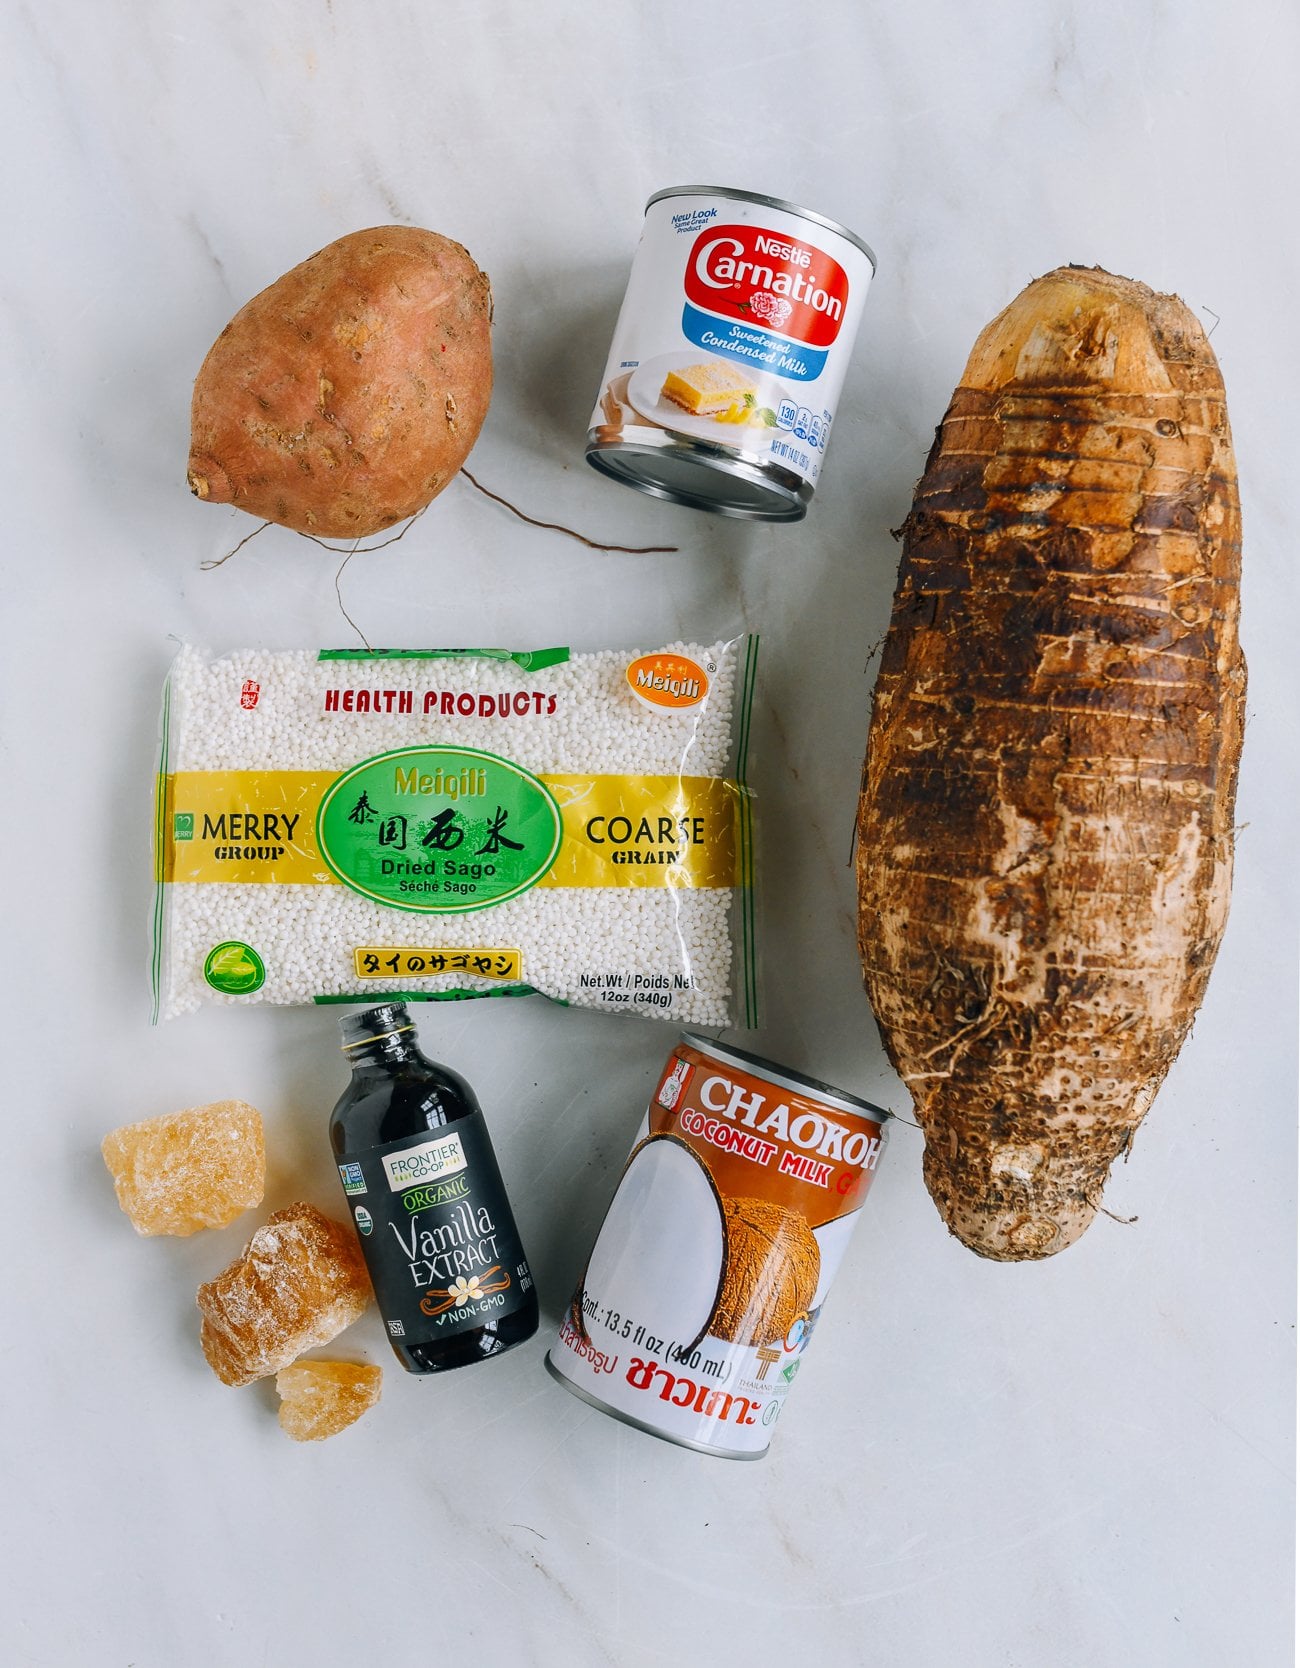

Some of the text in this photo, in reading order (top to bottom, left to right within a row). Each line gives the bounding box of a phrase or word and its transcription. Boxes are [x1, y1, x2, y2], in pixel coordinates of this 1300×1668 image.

[671, 208, 718, 225] New Look
[696, 238, 842, 321] Carnation
[701, 332, 807, 376] Condensed Milk
[729, 326, 791, 354] Sweetened
[781, 406, 795, 421] 130
[325, 690, 558, 718] HEALTH PRODUCTS
[202, 814, 299, 840] MERRY
[215, 846, 285, 860] GROUP
[381, 860, 496, 879] Dried Sago
[400, 881, 477, 895] Séché Sago
[363, 953, 513, 975] タイのサゴヤシ
[634, 974, 670, 989] Poids
[601, 991, 673, 1008] 12oz (340g)
[681, 1108, 778, 1166] COCONUT
[700, 1076, 883, 1170] CHAOKOH
[390, 1143, 459, 1175] FRONTIER
[412, 1161, 444, 1178] CO-OP
[403, 1177, 469, 1210] ORGANIC
[388, 1201, 495, 1261] Vanilla
[408, 1235, 500, 1287] EXTRACT
[448, 1293, 505, 1324] NON-GMO
[605, 1310, 633, 1338] 13.5
[633, 1326, 646, 1346] fl
[645, 1336, 664, 1355] oz
[626, 1357, 761, 1425] ชาวเกาะ
